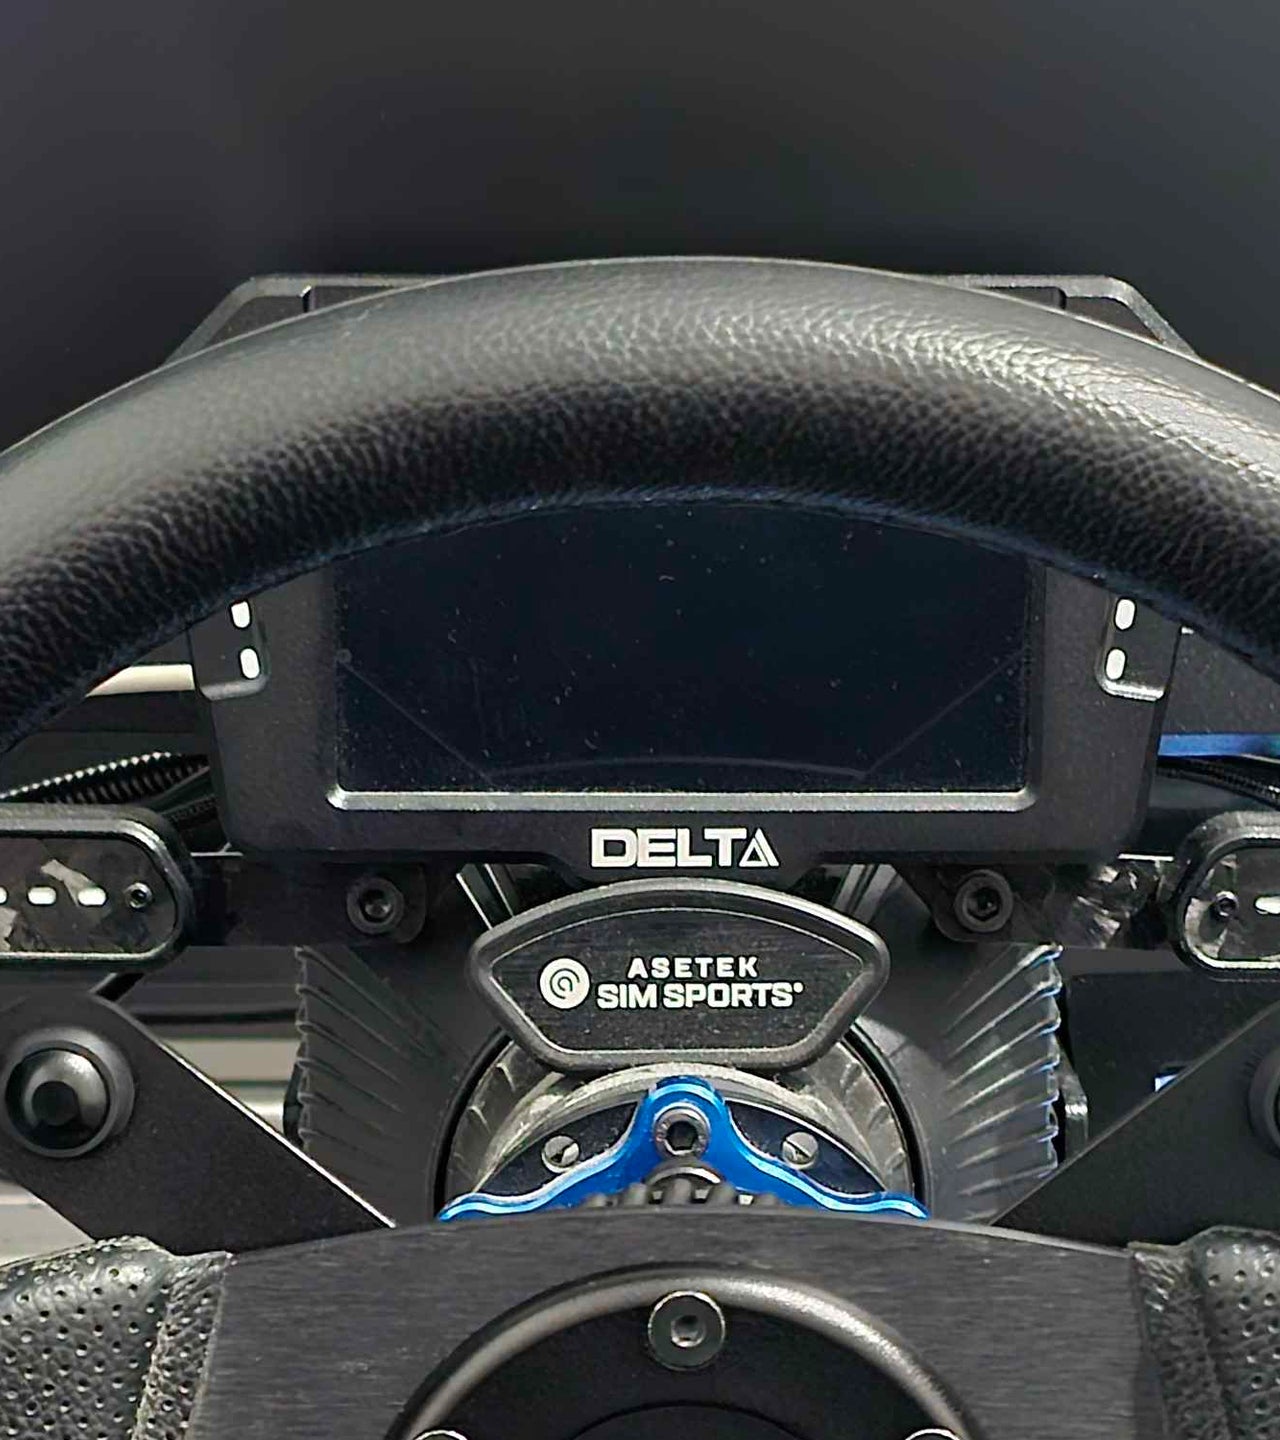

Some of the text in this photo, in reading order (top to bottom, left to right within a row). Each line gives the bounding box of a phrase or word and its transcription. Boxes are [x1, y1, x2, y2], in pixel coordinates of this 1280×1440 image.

[591, 827, 780, 868] DELTA
[627, 956, 758, 979] ASETEK
[596, 982, 794, 1009] SIM SPORTS
